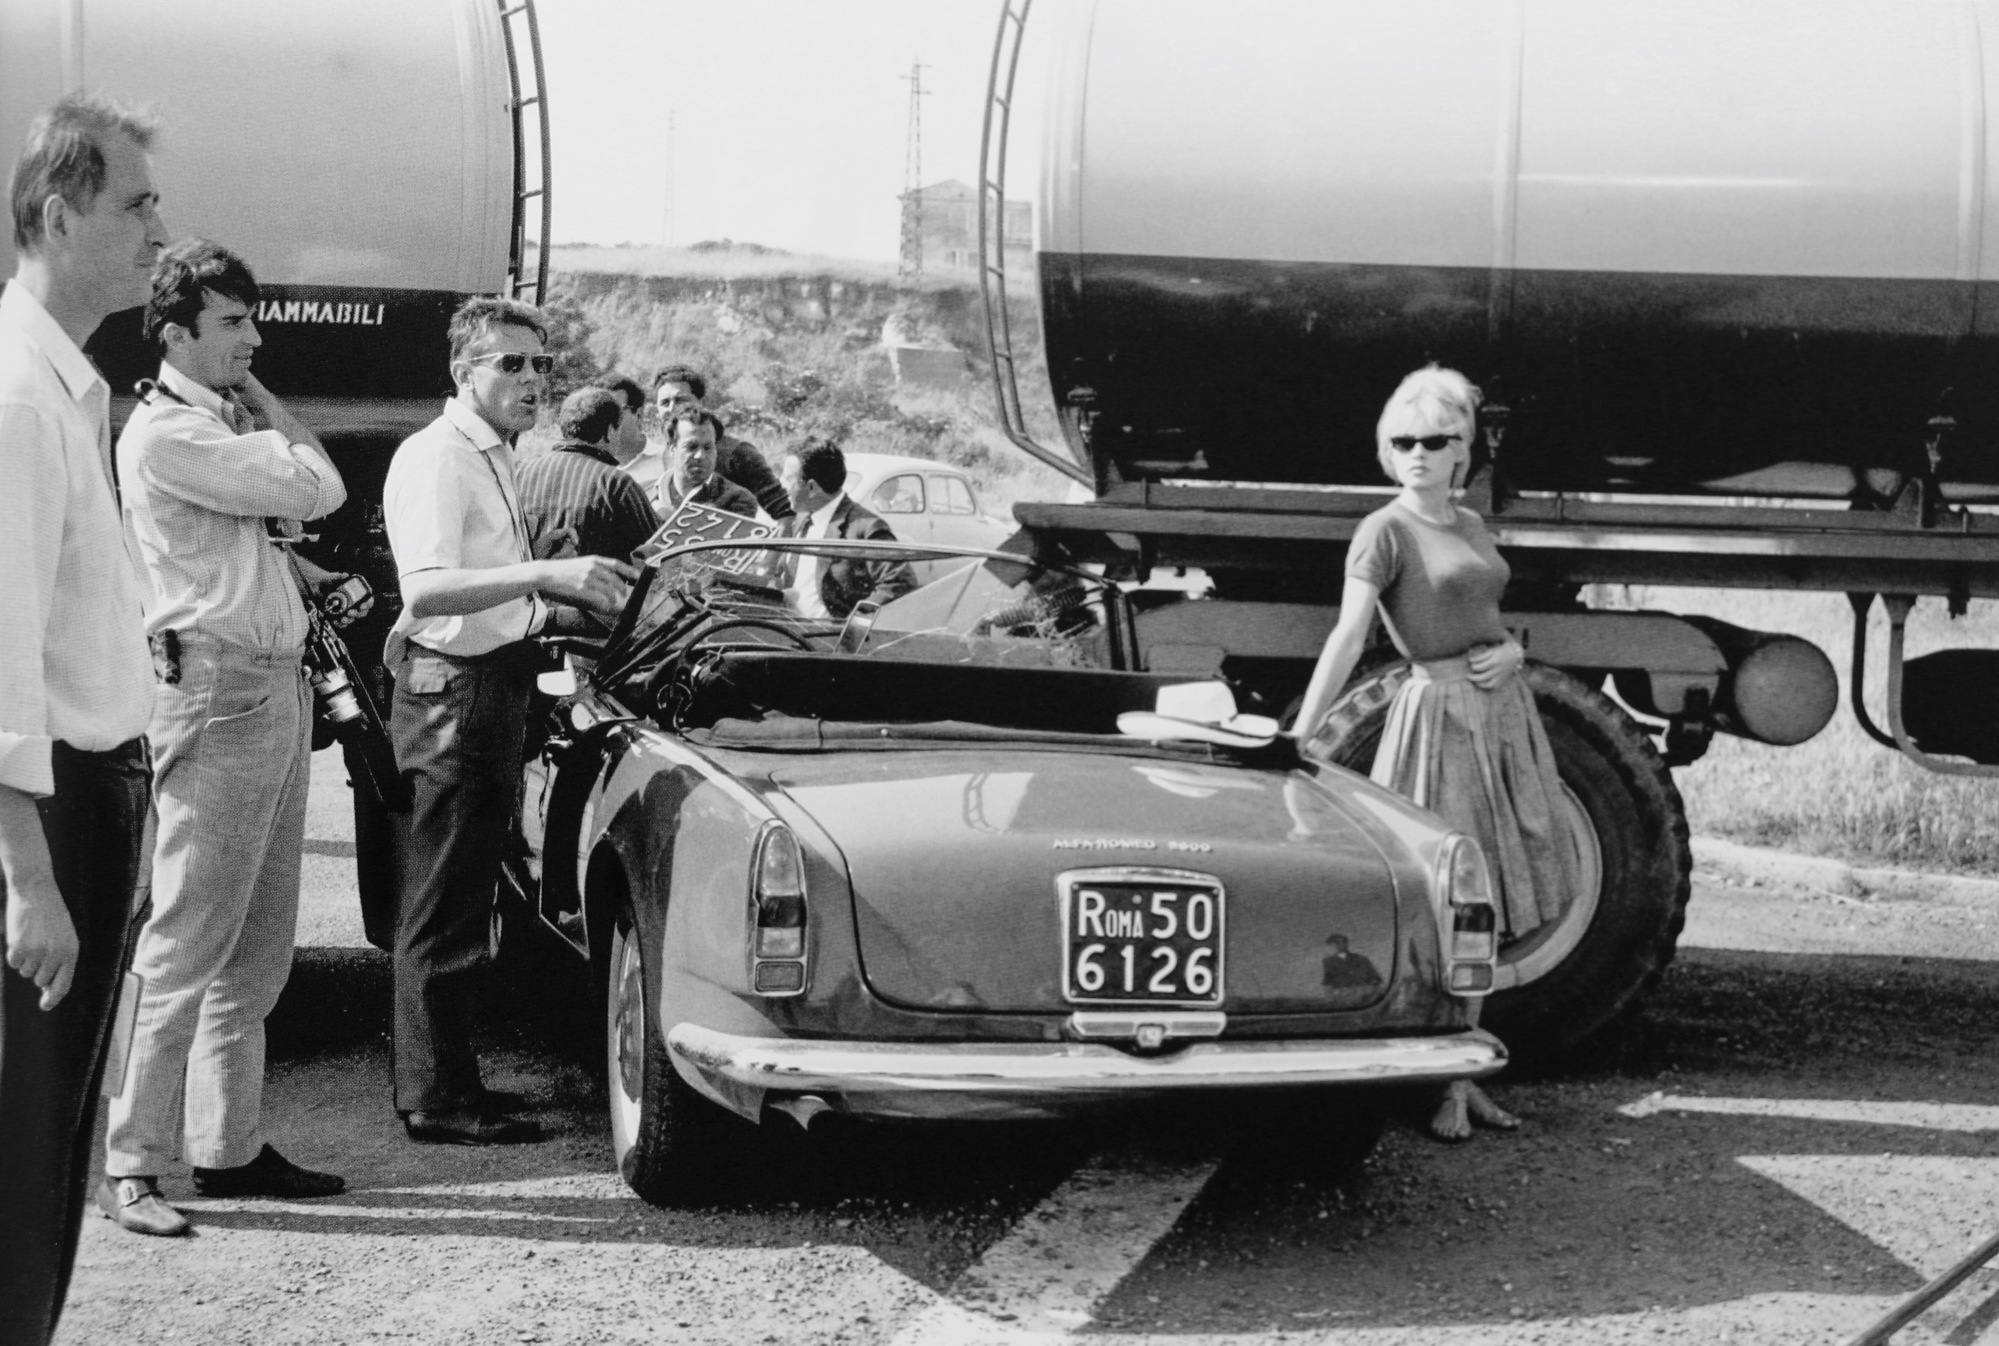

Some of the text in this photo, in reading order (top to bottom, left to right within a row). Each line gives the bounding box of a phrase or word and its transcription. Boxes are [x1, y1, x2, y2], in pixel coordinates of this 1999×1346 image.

[258, 300, 385, 325] IAMMABILI
[1151, 892, 1213, 941] 50
[1077, 943, 1213, 995] 6126
